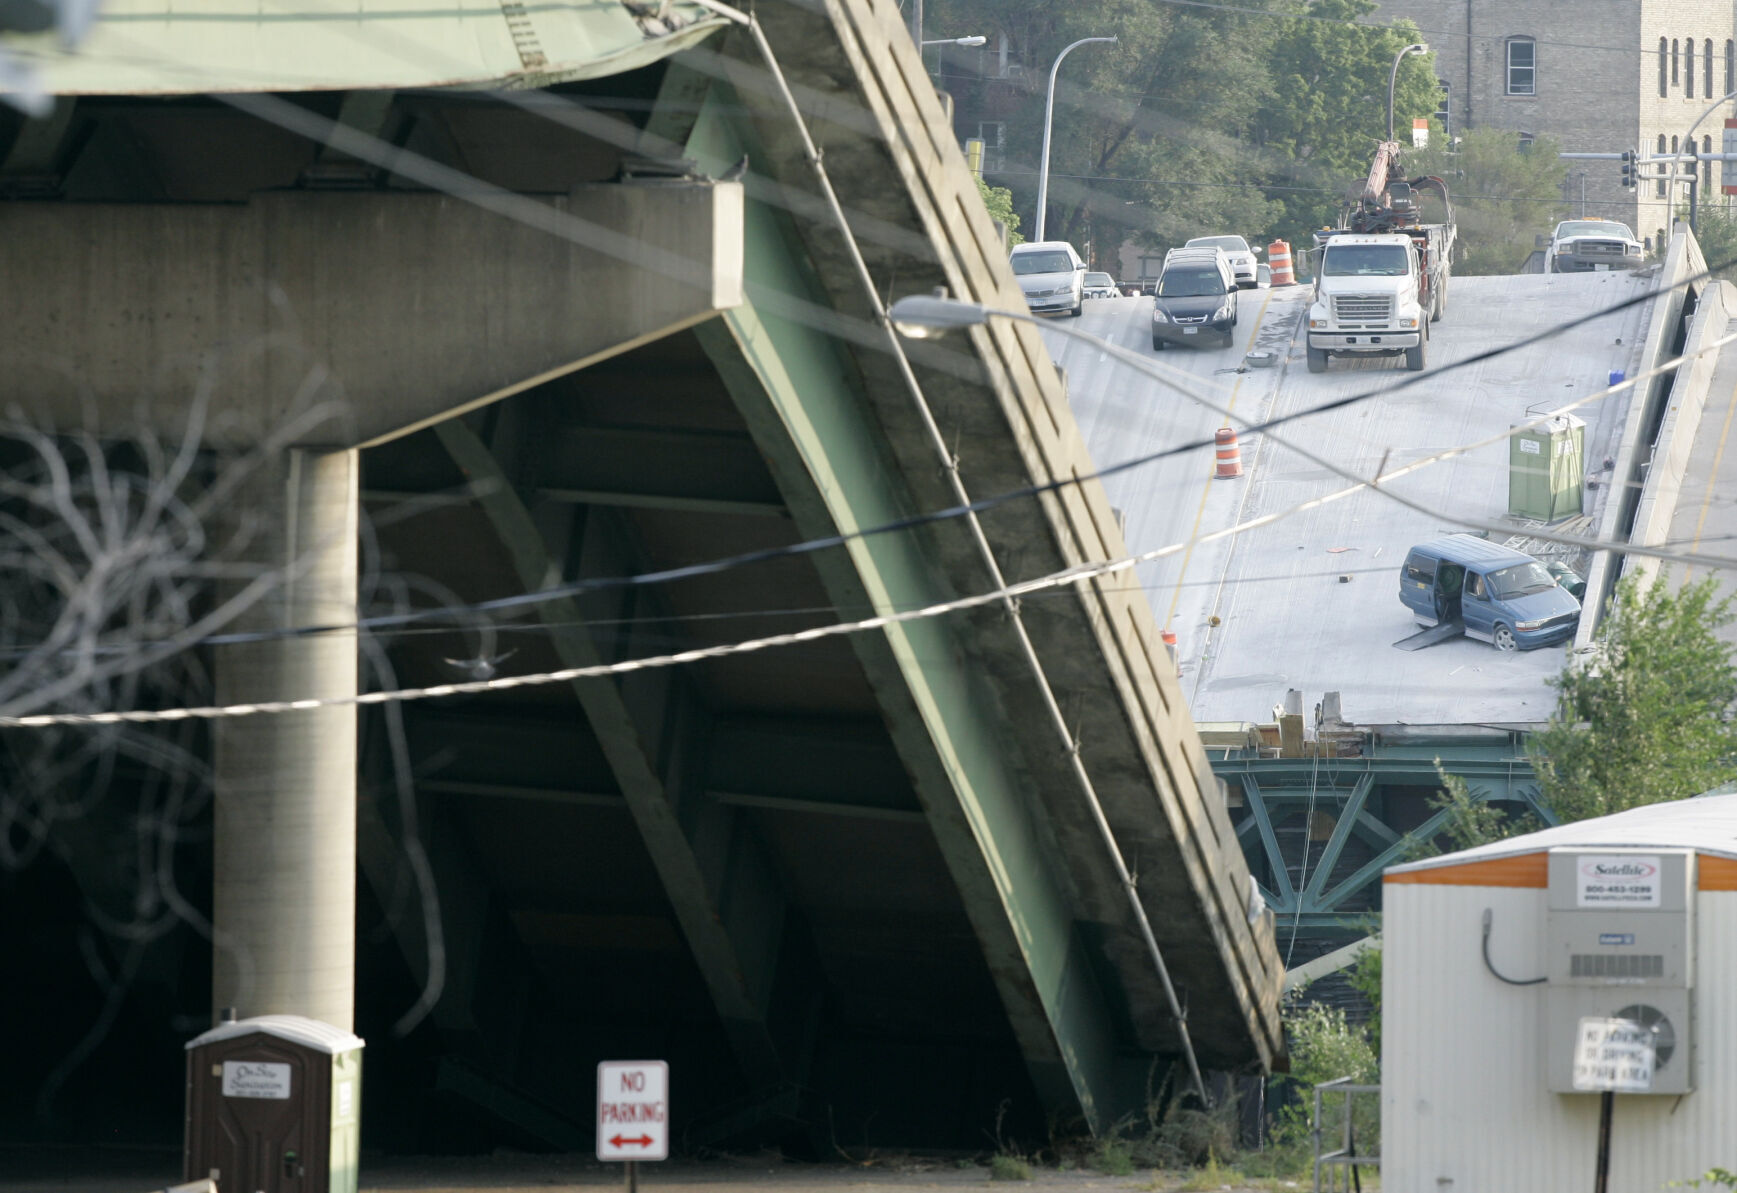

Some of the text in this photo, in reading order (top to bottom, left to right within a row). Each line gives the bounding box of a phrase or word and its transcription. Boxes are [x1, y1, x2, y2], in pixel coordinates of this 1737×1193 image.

[1595, 863, 1645, 875] Satellite
[620, 1071, 645, 1093] NO
[601, 1102, 665, 1124] PARKING
